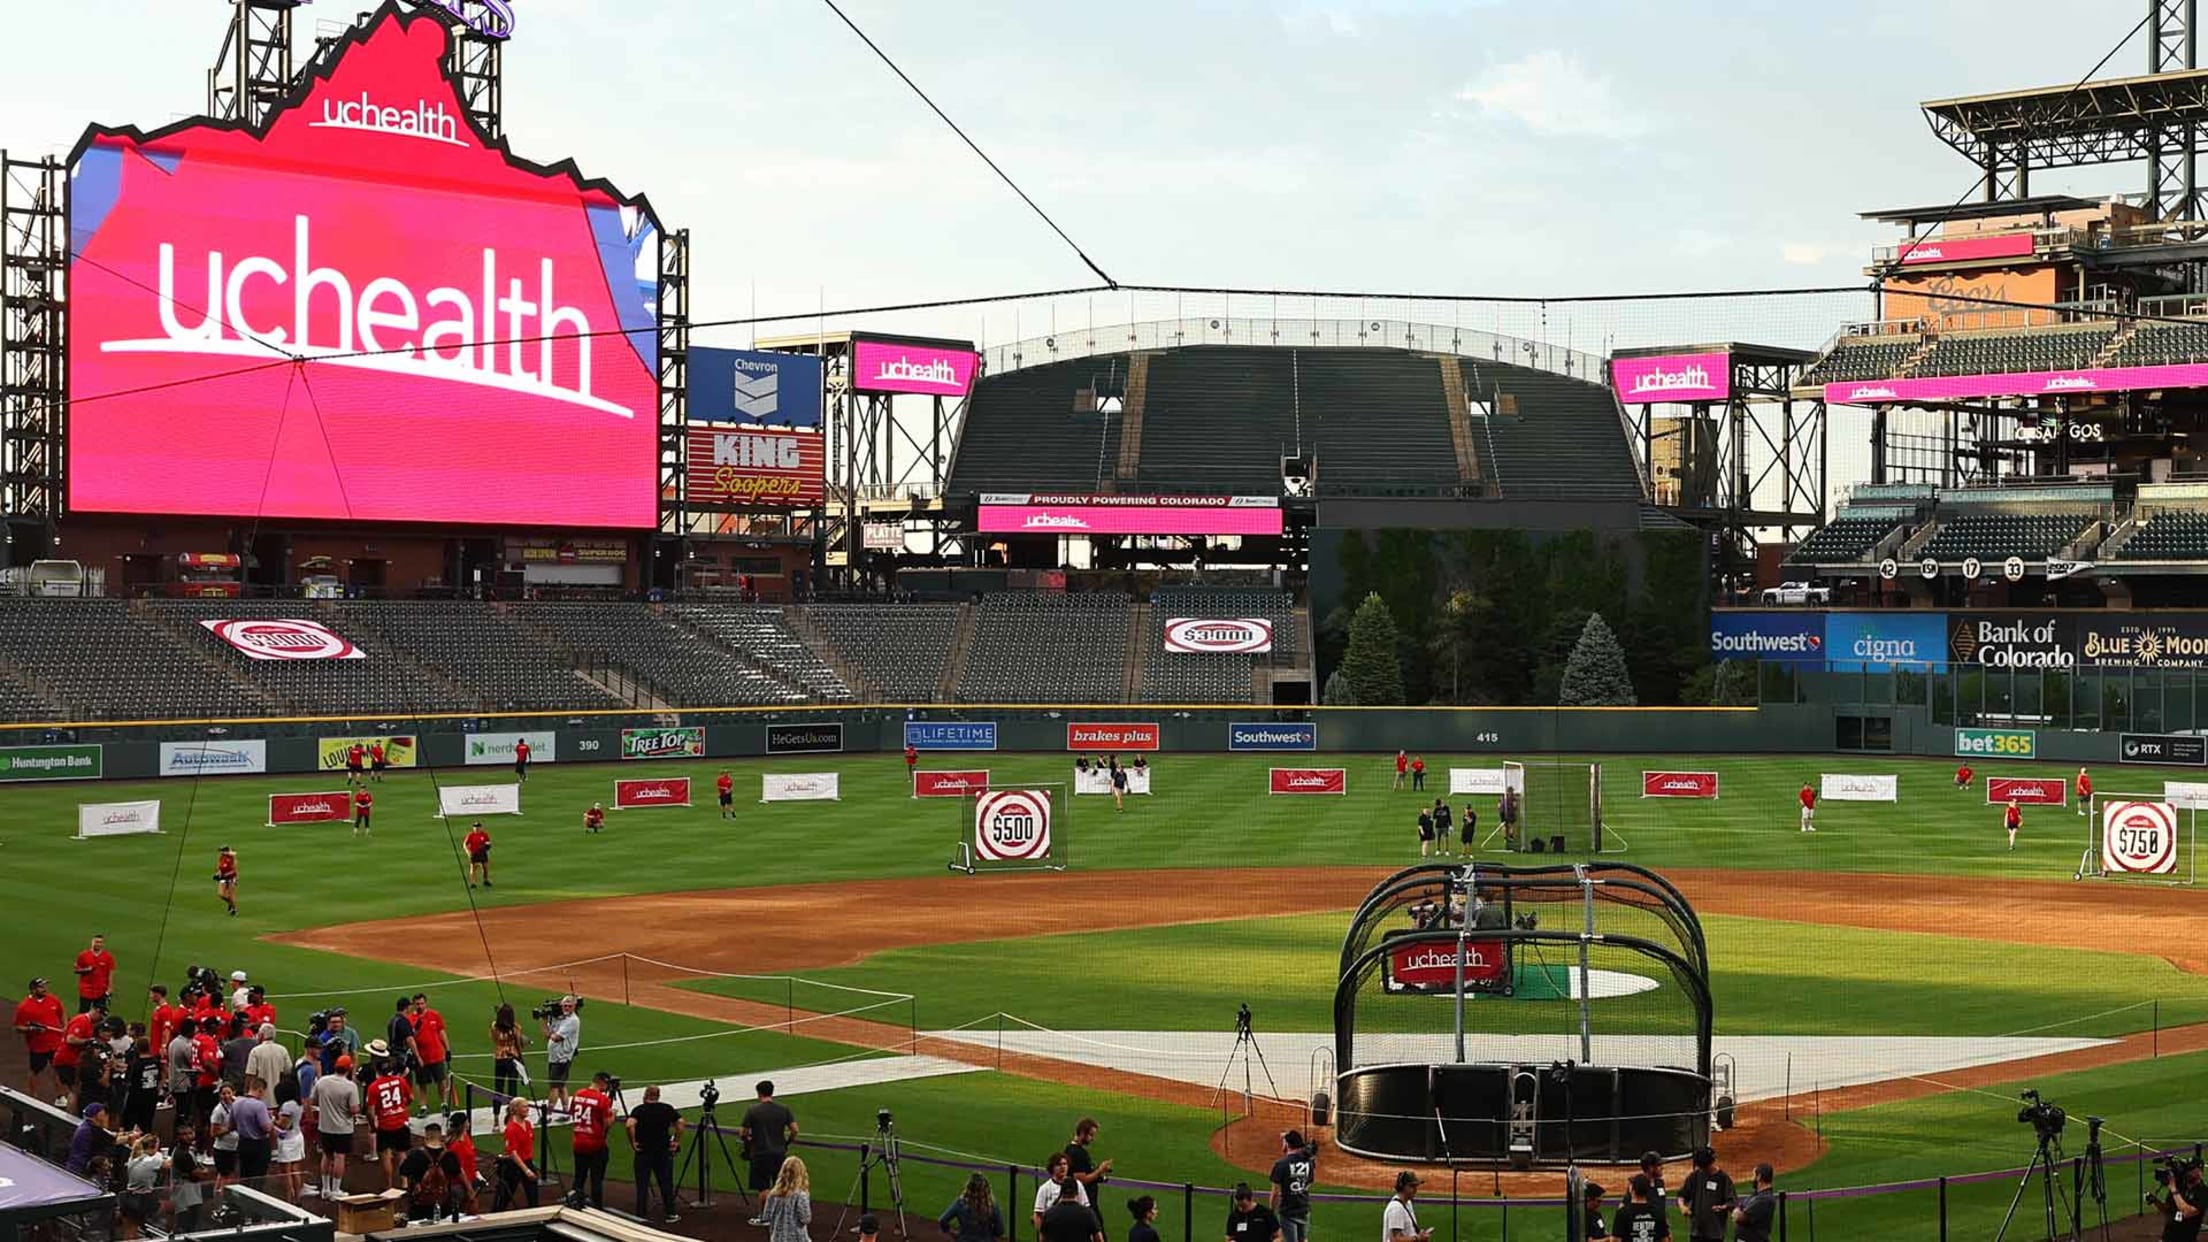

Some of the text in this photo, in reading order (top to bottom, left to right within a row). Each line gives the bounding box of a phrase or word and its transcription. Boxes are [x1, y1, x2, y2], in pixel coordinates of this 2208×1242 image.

[324, 92, 456, 140] uchealth
[157, 214, 592, 397] uchealth
[1927, 278, 2006, 316] Coors
[734, 358, 778, 372] Chevron
[881, 356, 955, 384] uchealth
[1636, 364, 1709, 389] uchealth
[714, 434, 800, 469] KING
[712, 467, 801, 501] Soopers
[1034, 496, 1089, 504] PROUDLY
[1093, 496, 1156, 505] POWERING
[1160, 497, 1226, 505] COLORADO
[866, 527, 903, 538] PLATTE
[1881, 563, 1893, 576] 42
[1965, 563, 1977, 576] 17
[2008, 563, 2020, 576] 33
[2048, 562, 2076, 570] 2007
[1711, 630, 1807, 651] Southwest
[1978, 619, 2056, 643] Bank of
[1853, 634, 1915, 662] cigna
[2166, 635, 2208, 655] MOO
[1978, 643, 2075, 668] Colorado
[2094, 658, 2204, 667] BREWING COMPANY
[630, 736, 660, 753] TREE
[659, 732, 685, 748] TOP
[772, 731, 837, 745] HeGetsUs.com
[922, 728, 993, 739] LIFETIME
[1073, 730, 1152, 743] brakes plus
[1234, 731, 1301, 743] Southwest
[1476, 732, 1498, 742] 415
[1958, 732, 2032, 754] bet365
[579, 740, 599, 751] 390
[2140, 743, 2161, 754] RTX
[12, 755, 92, 770] Huntington Bank
[172, 750, 248, 765] Autowash
[993, 815, 1033, 843] $500
[2119, 827, 2159, 854] $750
[1408, 947, 1484, 968] ucheath
[380, 1086, 401, 1108] 24
[574, 1104, 592, 1125] 24
